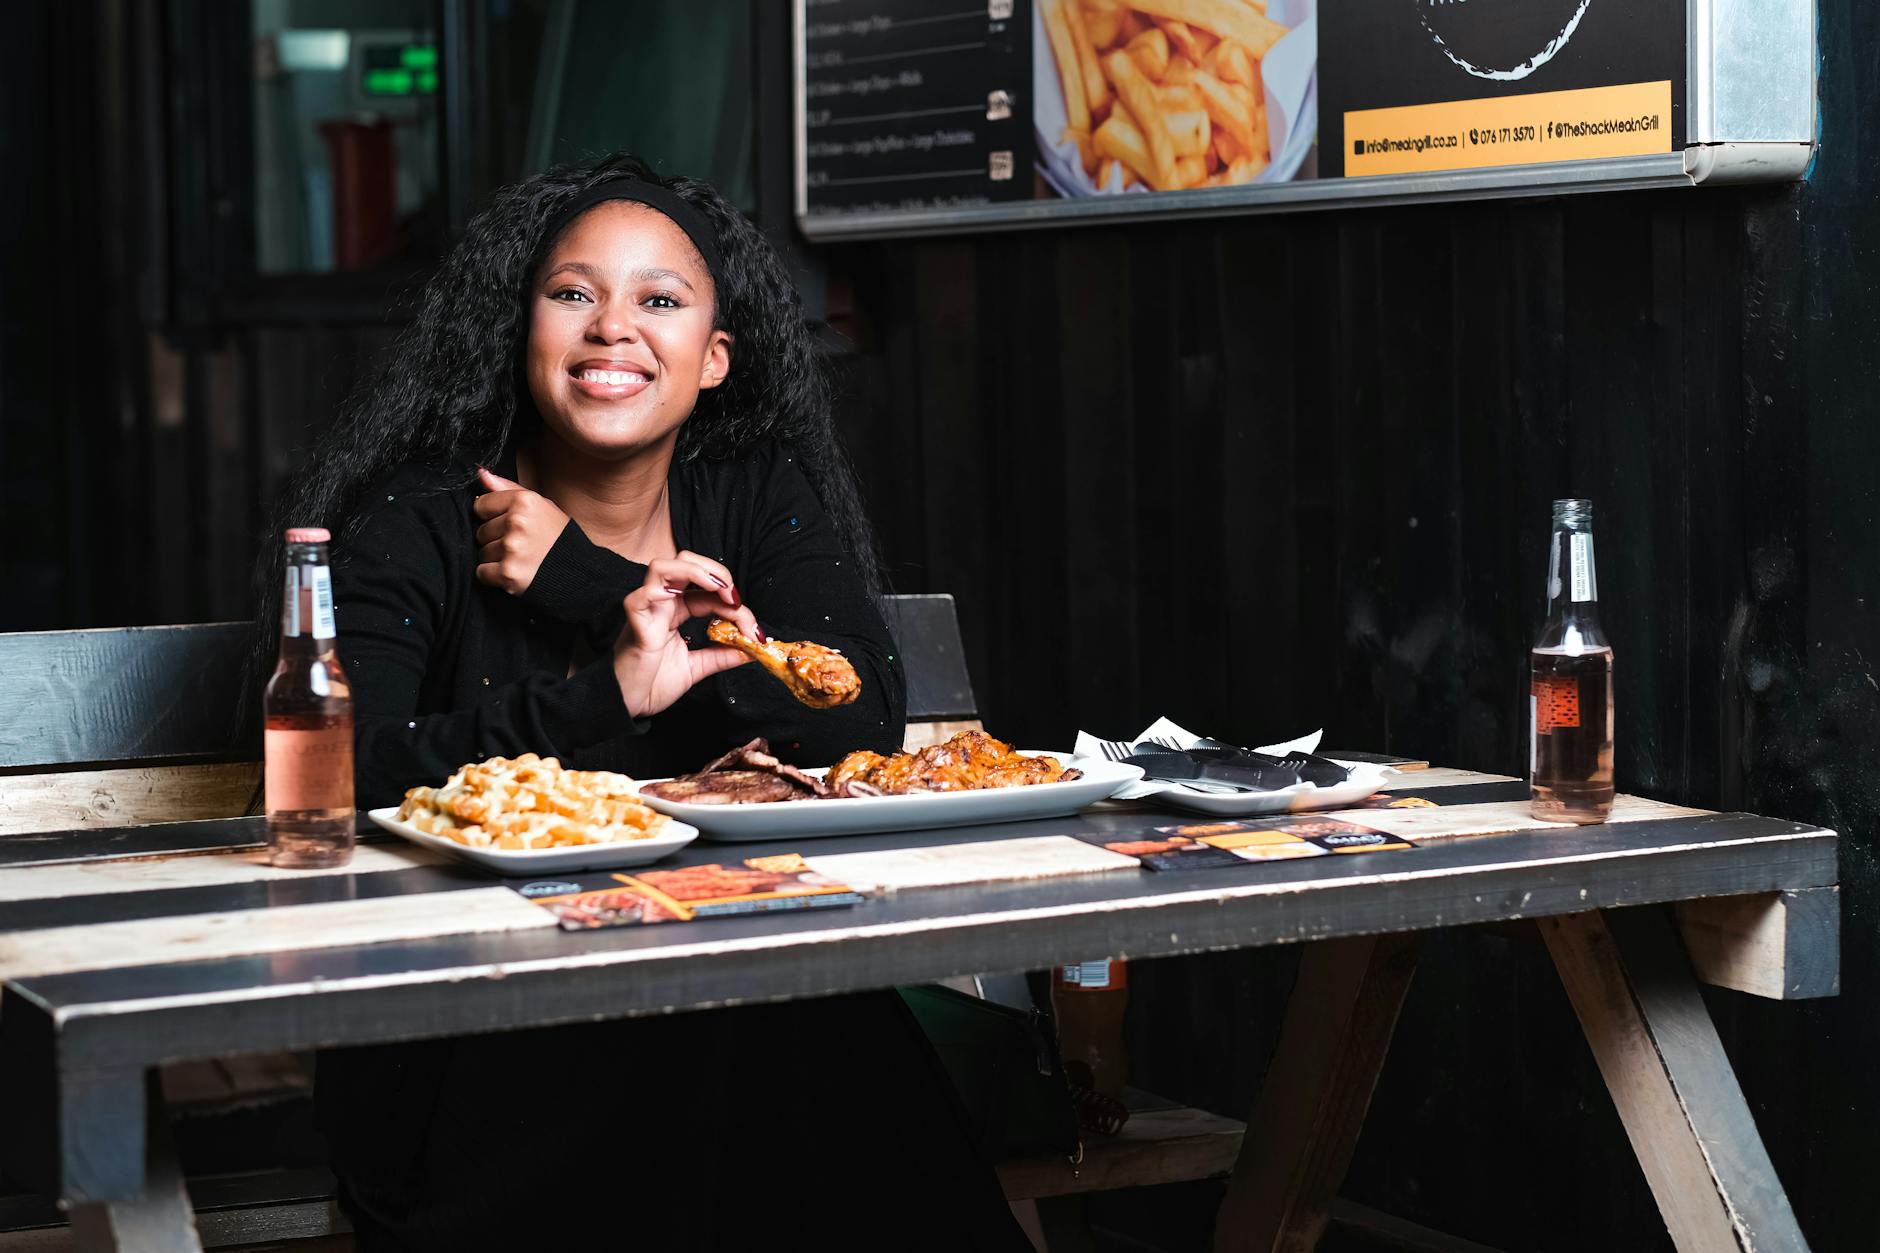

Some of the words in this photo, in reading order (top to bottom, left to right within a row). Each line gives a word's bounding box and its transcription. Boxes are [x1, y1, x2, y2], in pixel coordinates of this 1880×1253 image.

[1366, 134, 1458, 154] info@meatngrill.co.za
[1480, 129, 1497, 145] 076
[1498, 128, 1511, 143] 171
[1512, 125, 1535, 142] 3570
[1555, 115, 1659, 139] @TheShackMeatnGrill
